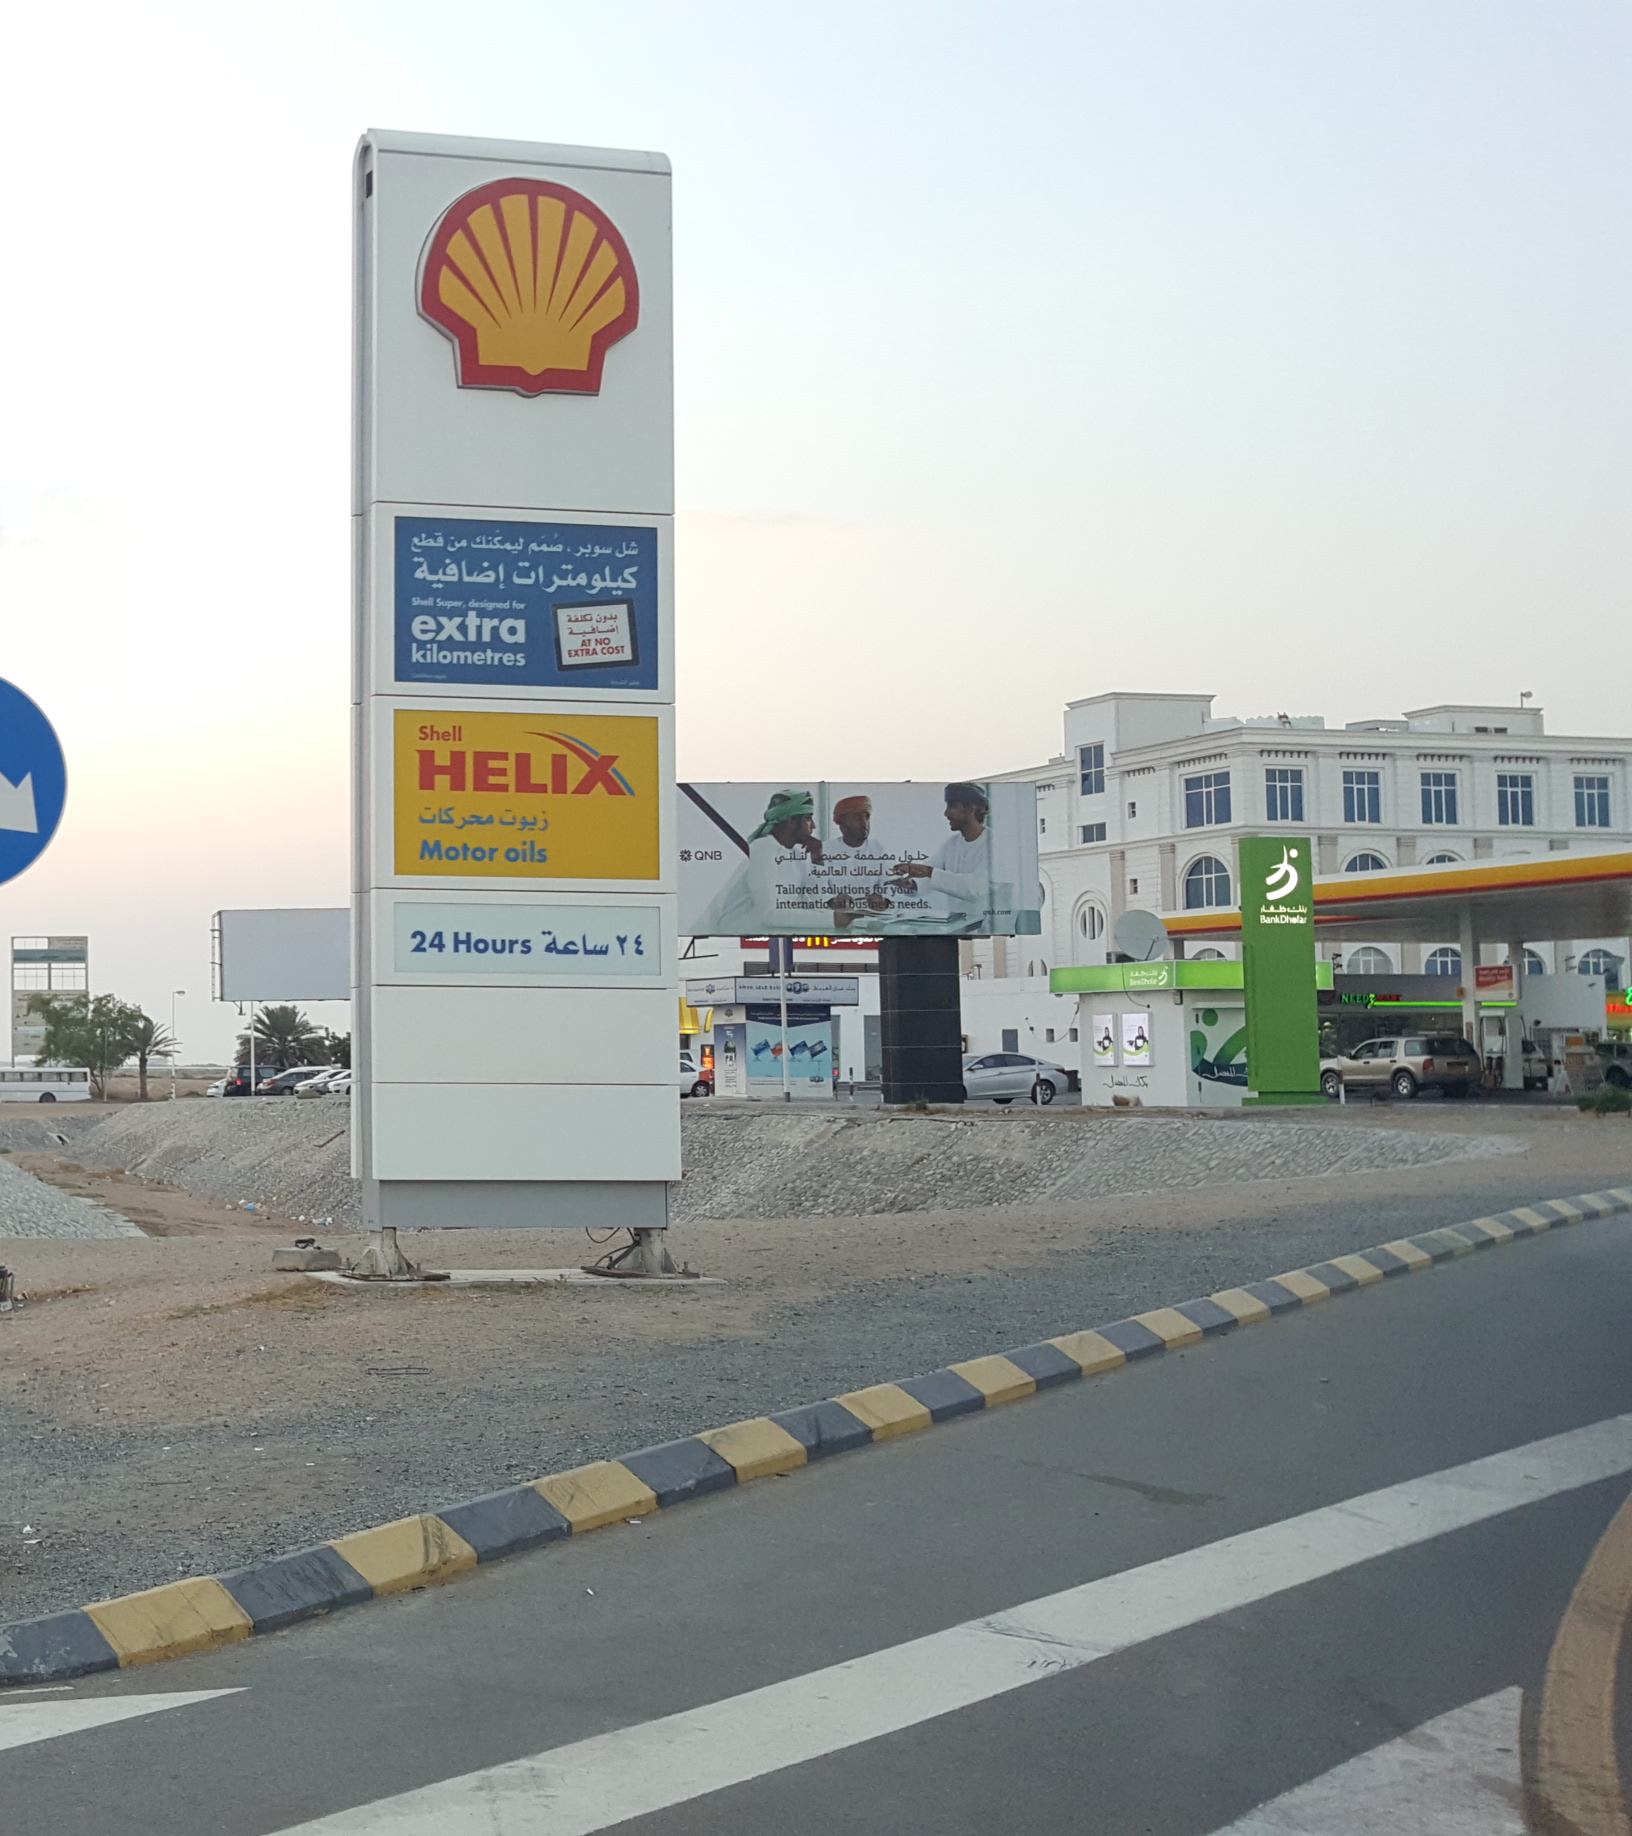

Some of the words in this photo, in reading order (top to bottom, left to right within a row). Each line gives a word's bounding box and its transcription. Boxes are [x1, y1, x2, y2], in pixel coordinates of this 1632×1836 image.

[410, 532, 444, 553] قطع
[447, 536, 467, 552] من
[614, 541, 639, 558] شل
[412, 557, 506, 589] إضافية
[512, 561, 639, 596] كيلومترات
[411, 597, 434, 607] Shell
[436, 598, 466, 609] Super,
[468, 599, 510, 610] designed
[512, 601, 527, 610] for
[566, 613, 593, 623] تكلفة
[595, 613, 618, 624] بدون
[411, 611, 526, 644] extra
[581, 639, 592, 648] AT
[595, 637, 611, 646] NO
[411, 643, 526, 667] kilometres
[567, 648, 598, 658] EXTRA
[601, 645, 625, 655] COST
[418, 725, 462, 742] Shell
[416, 749, 628, 796] HELIX
[418, 806, 495, 830] محركات
[499, 809, 549, 831] زيوت
[419, 839, 499, 862] Motor
[504, 841, 548, 863] oils
[694, 850, 723, 861] QNB
[854, 851, 896, 861] مصممة
[898, 850, 929, 863] حلول
[849, 863, 882, 876] أعمالك
[775, 884, 819, 895] Tailored
[821, 885, 871, 895] solutions
[873, 884, 888, 895] for
[890, 886, 915, 897] your
[897, 899, 932, 910] needs.
[1260, 914, 1308, 924] BankDhofar
[410, 930, 446, 953] 24
[453, 931, 532, 955] Hours
[541, 930, 609, 956] ساعة
